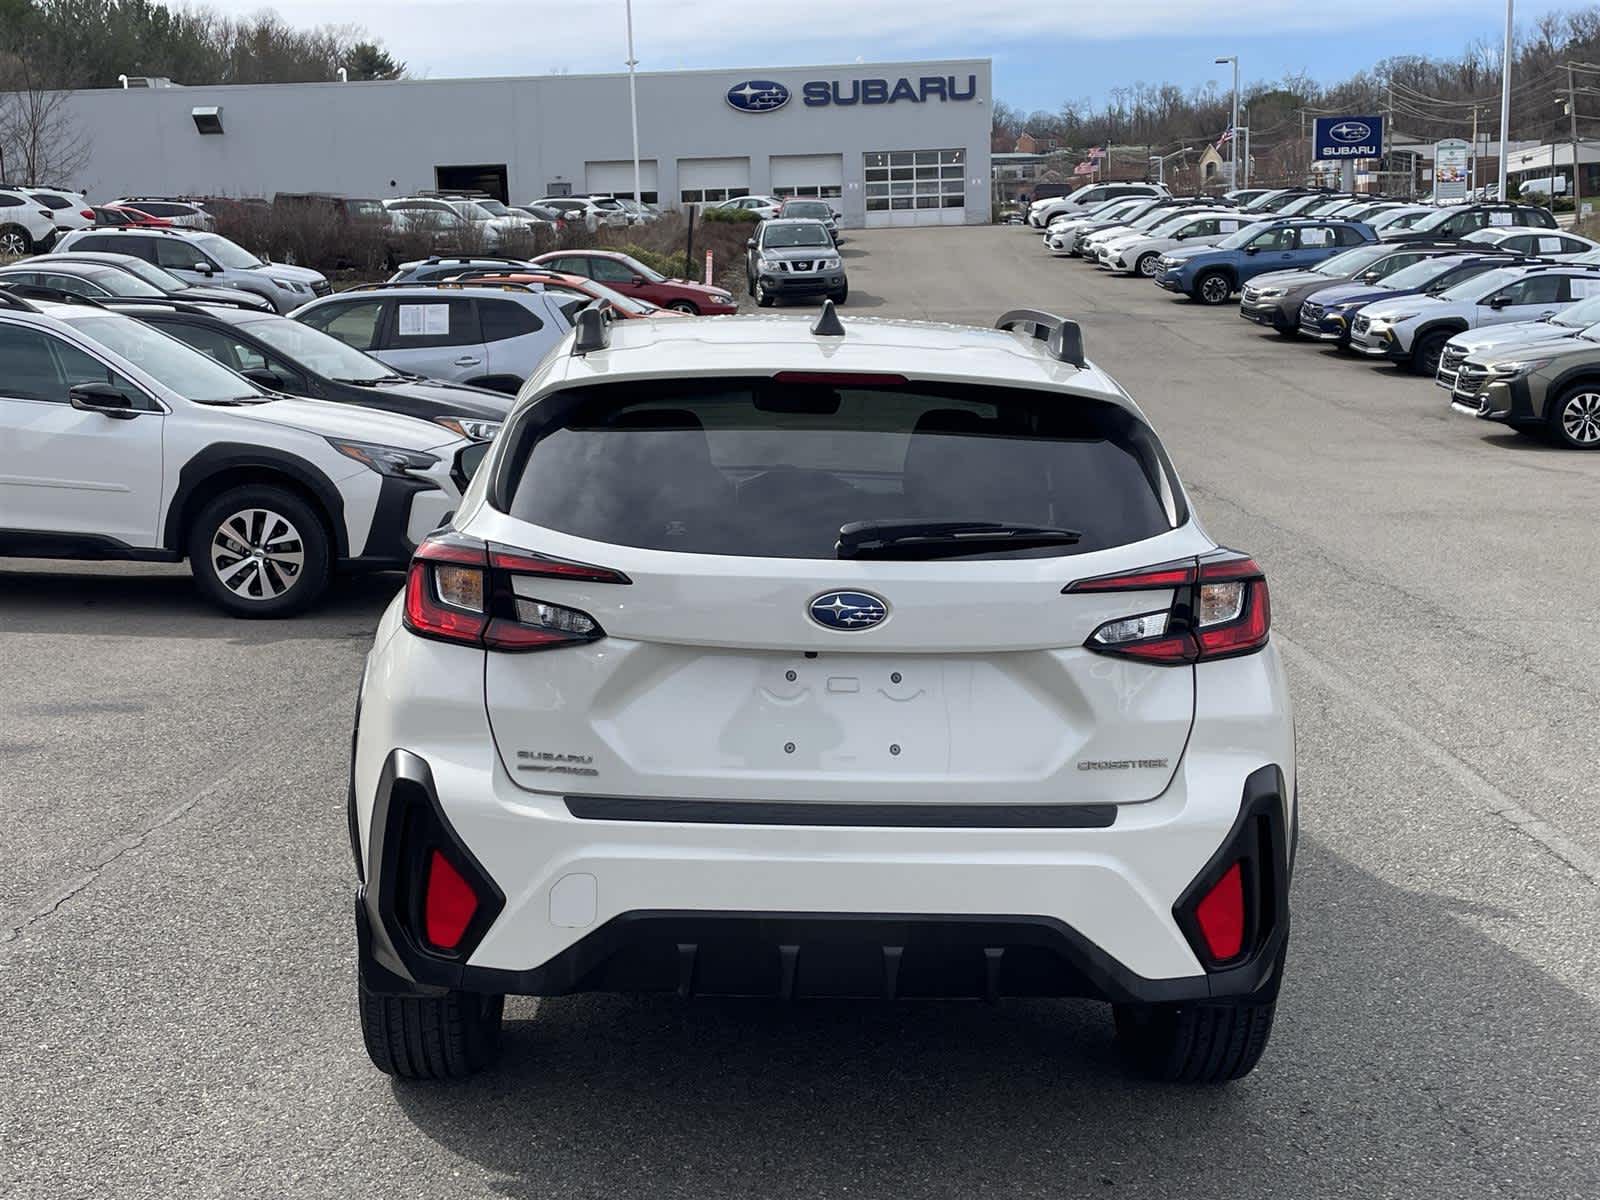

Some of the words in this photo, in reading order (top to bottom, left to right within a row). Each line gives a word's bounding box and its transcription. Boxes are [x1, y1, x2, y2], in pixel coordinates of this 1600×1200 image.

[802, 75, 976, 107] SUBARU
[1322, 145, 1376, 155] SUBARU
[517, 751, 593, 764] SUBARU
[1077, 759, 1168, 770] CROSSTREK
